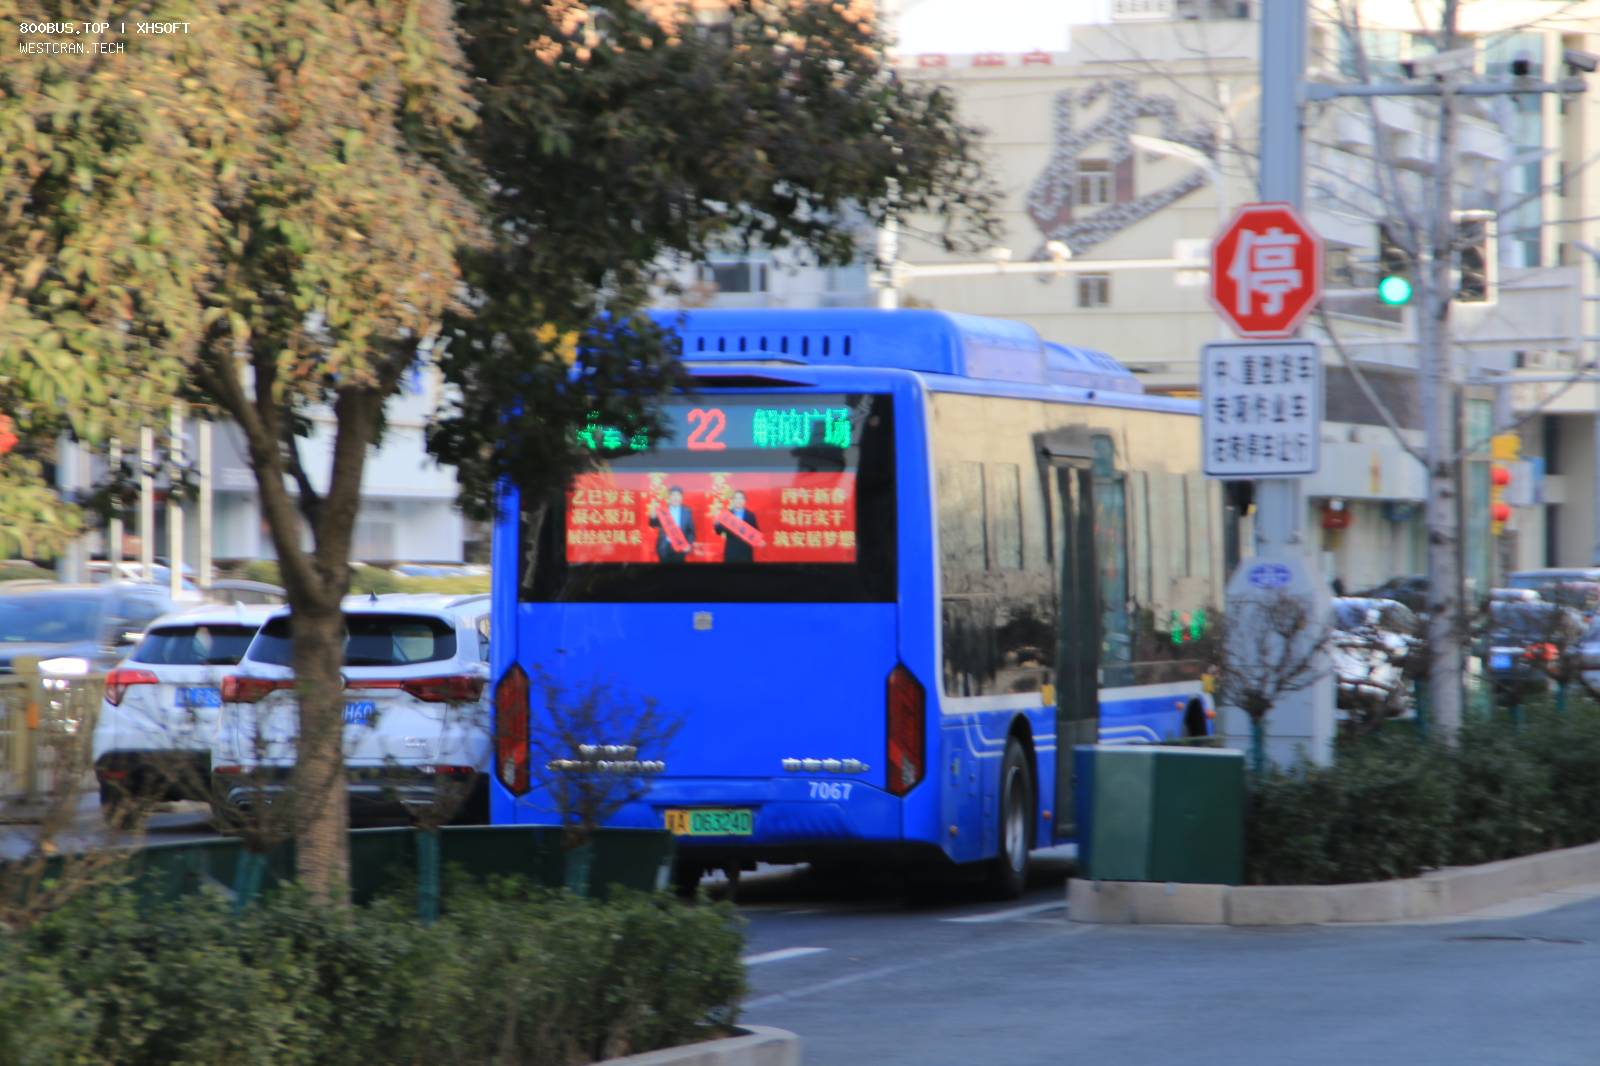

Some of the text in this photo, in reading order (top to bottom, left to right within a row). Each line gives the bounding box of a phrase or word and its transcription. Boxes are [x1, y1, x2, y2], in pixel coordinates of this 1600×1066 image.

[1226, 226, 1303, 316] 停
[687, 408, 726, 449] 22
[753, 408, 851, 449] 解放广场
[808, 781, 853, 800] 7067
